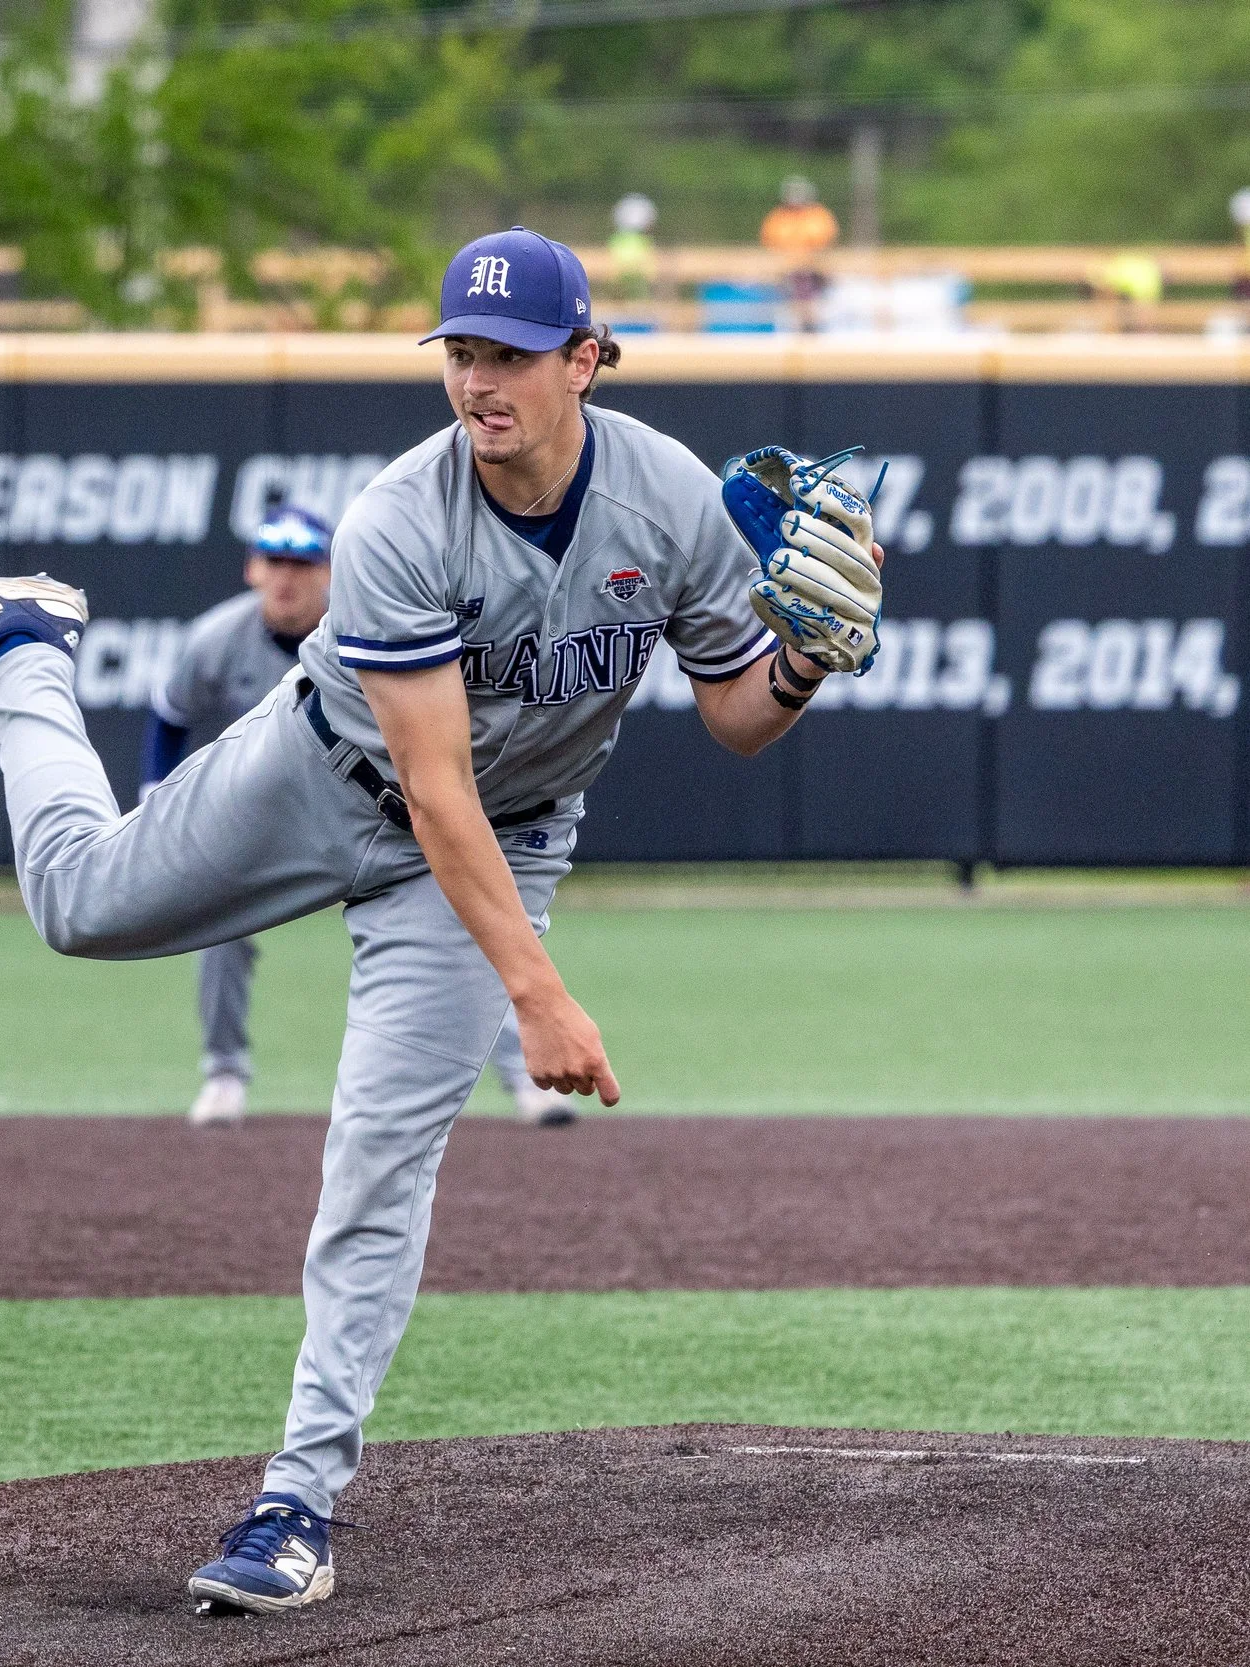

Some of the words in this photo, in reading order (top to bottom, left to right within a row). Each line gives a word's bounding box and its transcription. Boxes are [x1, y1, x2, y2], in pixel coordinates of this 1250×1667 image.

[467, 255, 512, 299] M
[951, 455, 1176, 553] 2008,
[604, 576, 647, 590] AMERICA
[613, 585, 637, 593] EAST
[1029, 617, 1241, 718] 2014,
